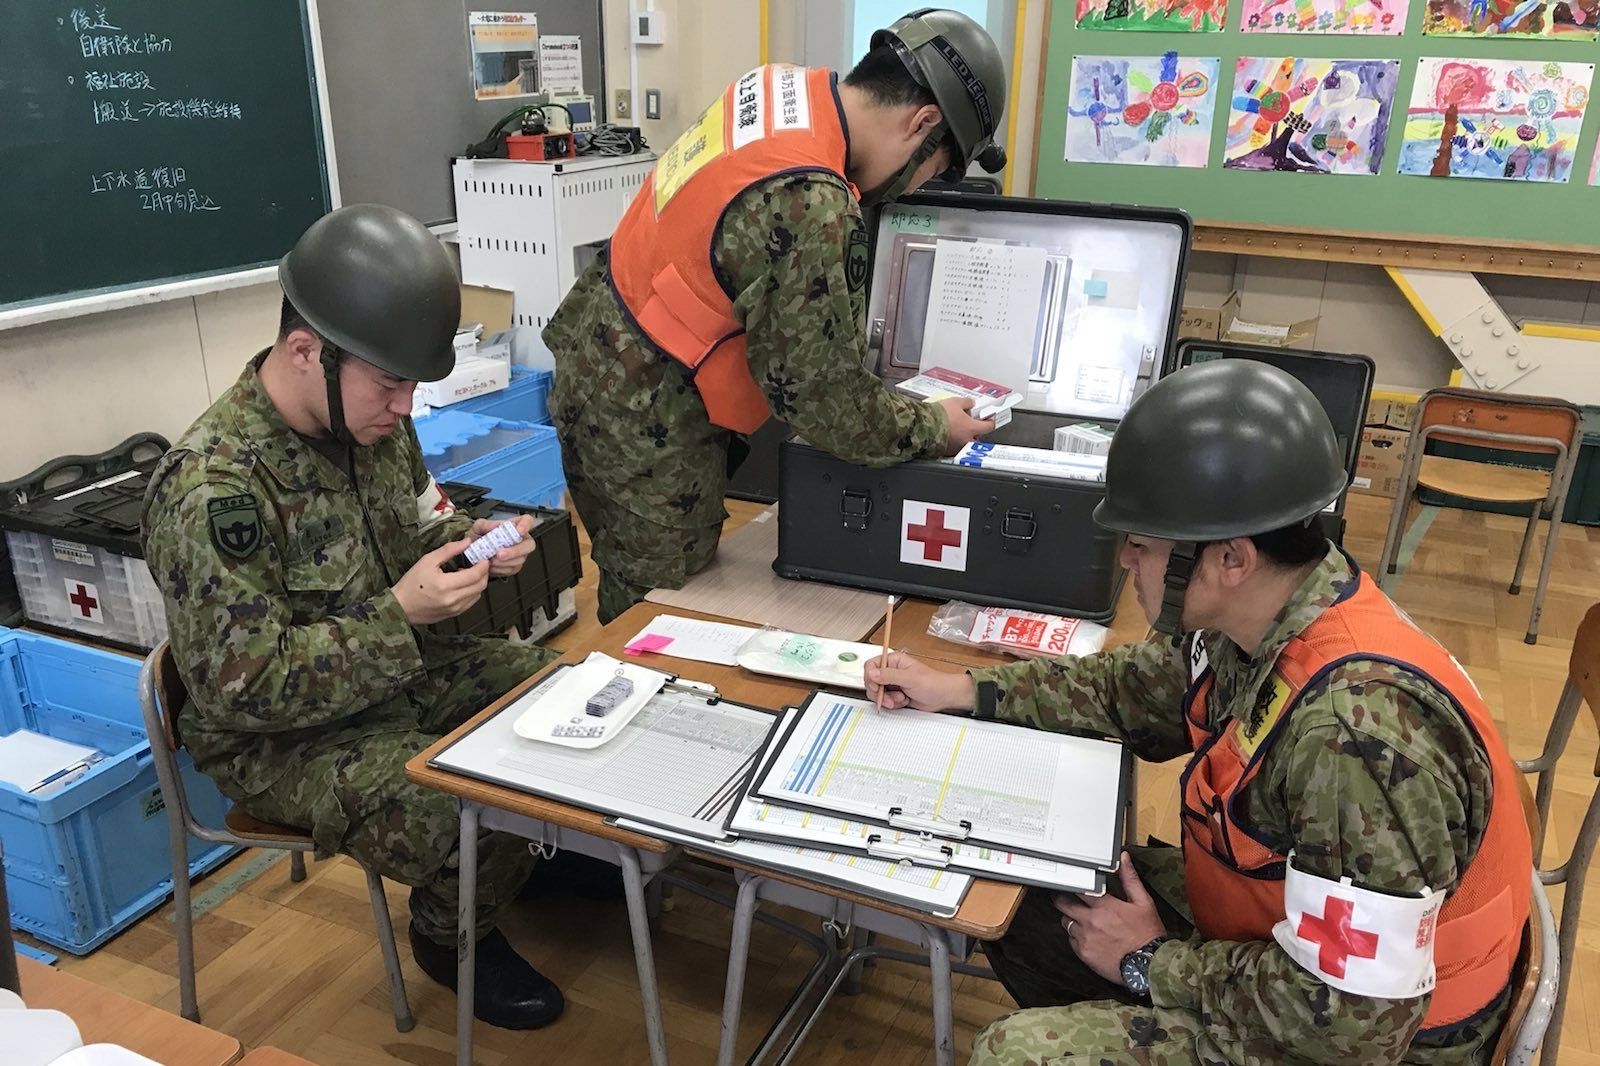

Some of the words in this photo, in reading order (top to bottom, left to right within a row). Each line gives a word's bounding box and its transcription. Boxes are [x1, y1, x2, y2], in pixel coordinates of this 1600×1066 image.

[70, 5, 121, 32] 後送
[80, 33, 172, 58] 自衛隊と協力
[943, 46, 969, 74] LED
[85, 70, 156, 92] 福祉施設
[91, 167, 187, 194] 上下水道復旧
[139, 188, 222, 214] 2月中旬見込
[220, 496, 245, 508] Med
[1004, 626, 1020, 642] B7
